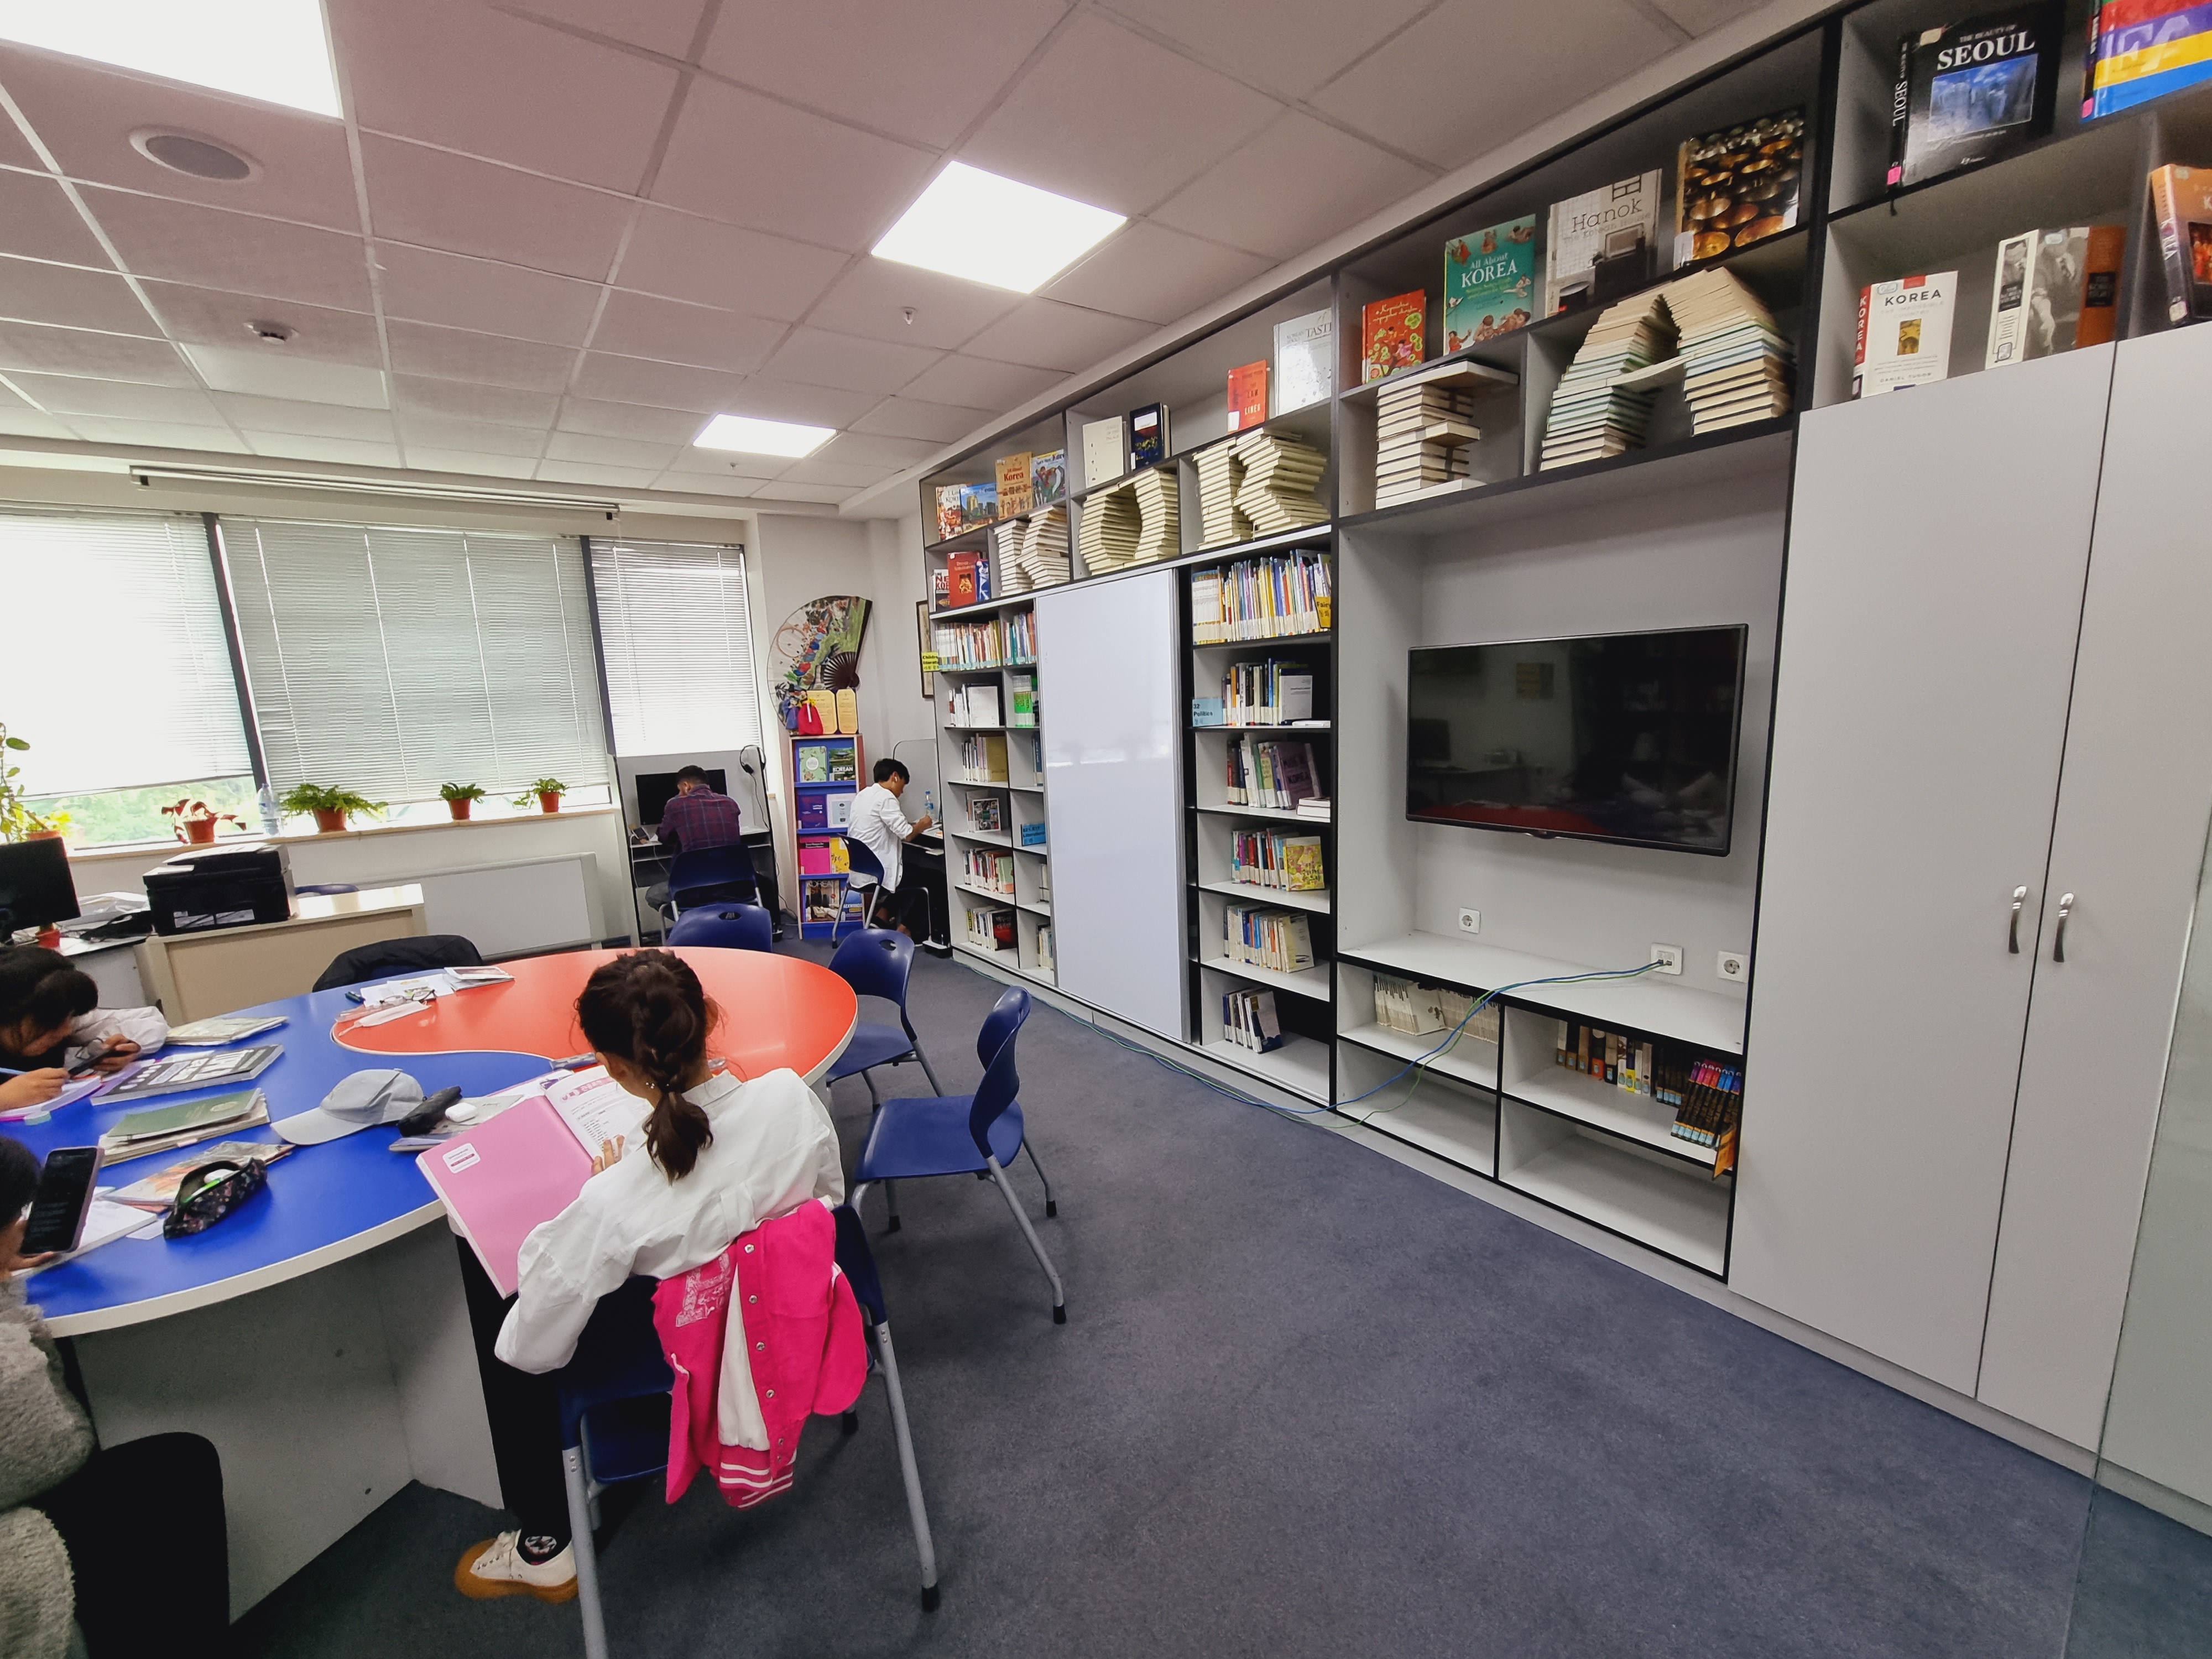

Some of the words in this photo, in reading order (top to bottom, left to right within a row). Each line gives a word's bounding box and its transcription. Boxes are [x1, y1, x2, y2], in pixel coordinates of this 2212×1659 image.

[1937, 30, 2036, 71] SEOUL
[1892, 81, 1907, 127] SEOUL
[1572, 198, 1642, 233] Hanok
[1461, 259, 1518, 288] KOREA
[1470, 259, 1481, 269] All
[1483, 252, 1509, 266] About
[1885, 289, 1942, 306] KOREA
[1856, 295, 1867, 351] KOREA
[1004, 472, 1024, 482] Korea
